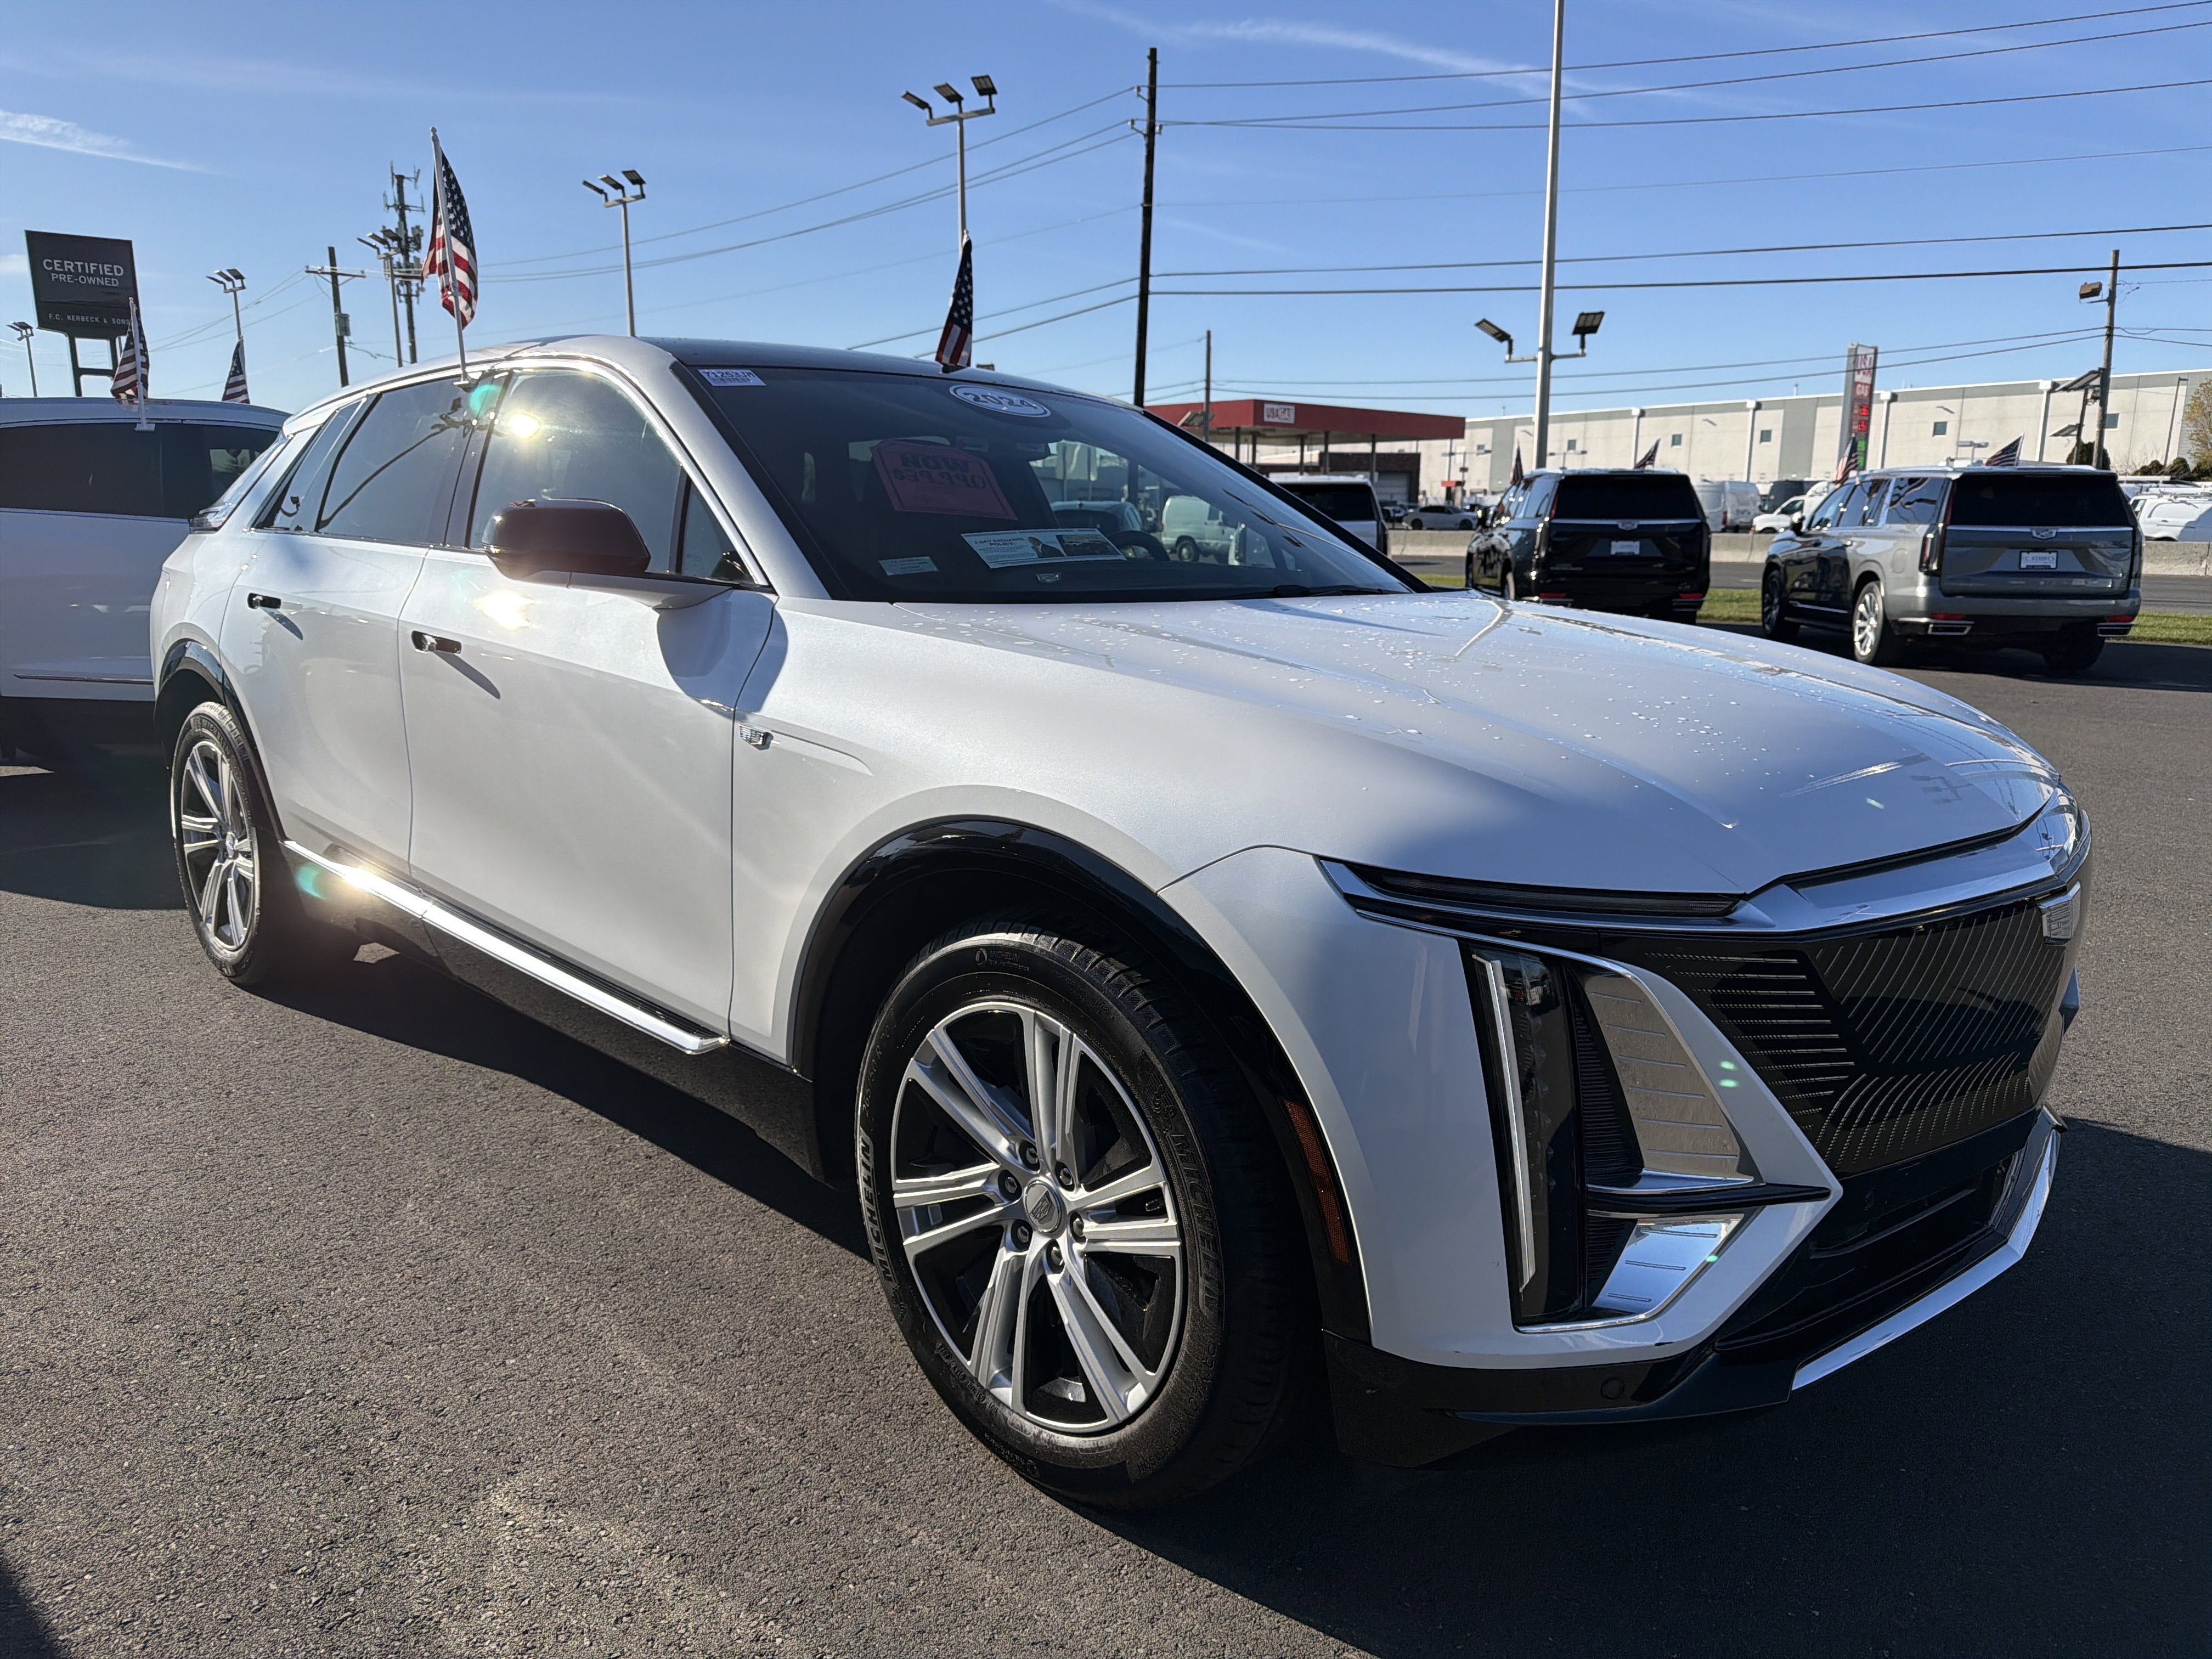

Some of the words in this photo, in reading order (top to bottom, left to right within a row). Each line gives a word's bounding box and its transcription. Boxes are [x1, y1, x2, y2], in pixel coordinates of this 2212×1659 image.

[43, 259, 124, 276] CERTIFIED
[52, 273, 119, 286] PRE-OWNED
[67, 314, 100, 323] KERBECK
[963, 392, 1037, 409] 2024
[860, 1136, 893, 1283] MICHELIN
[1171, 1133, 1218, 1313] MICHELIN
